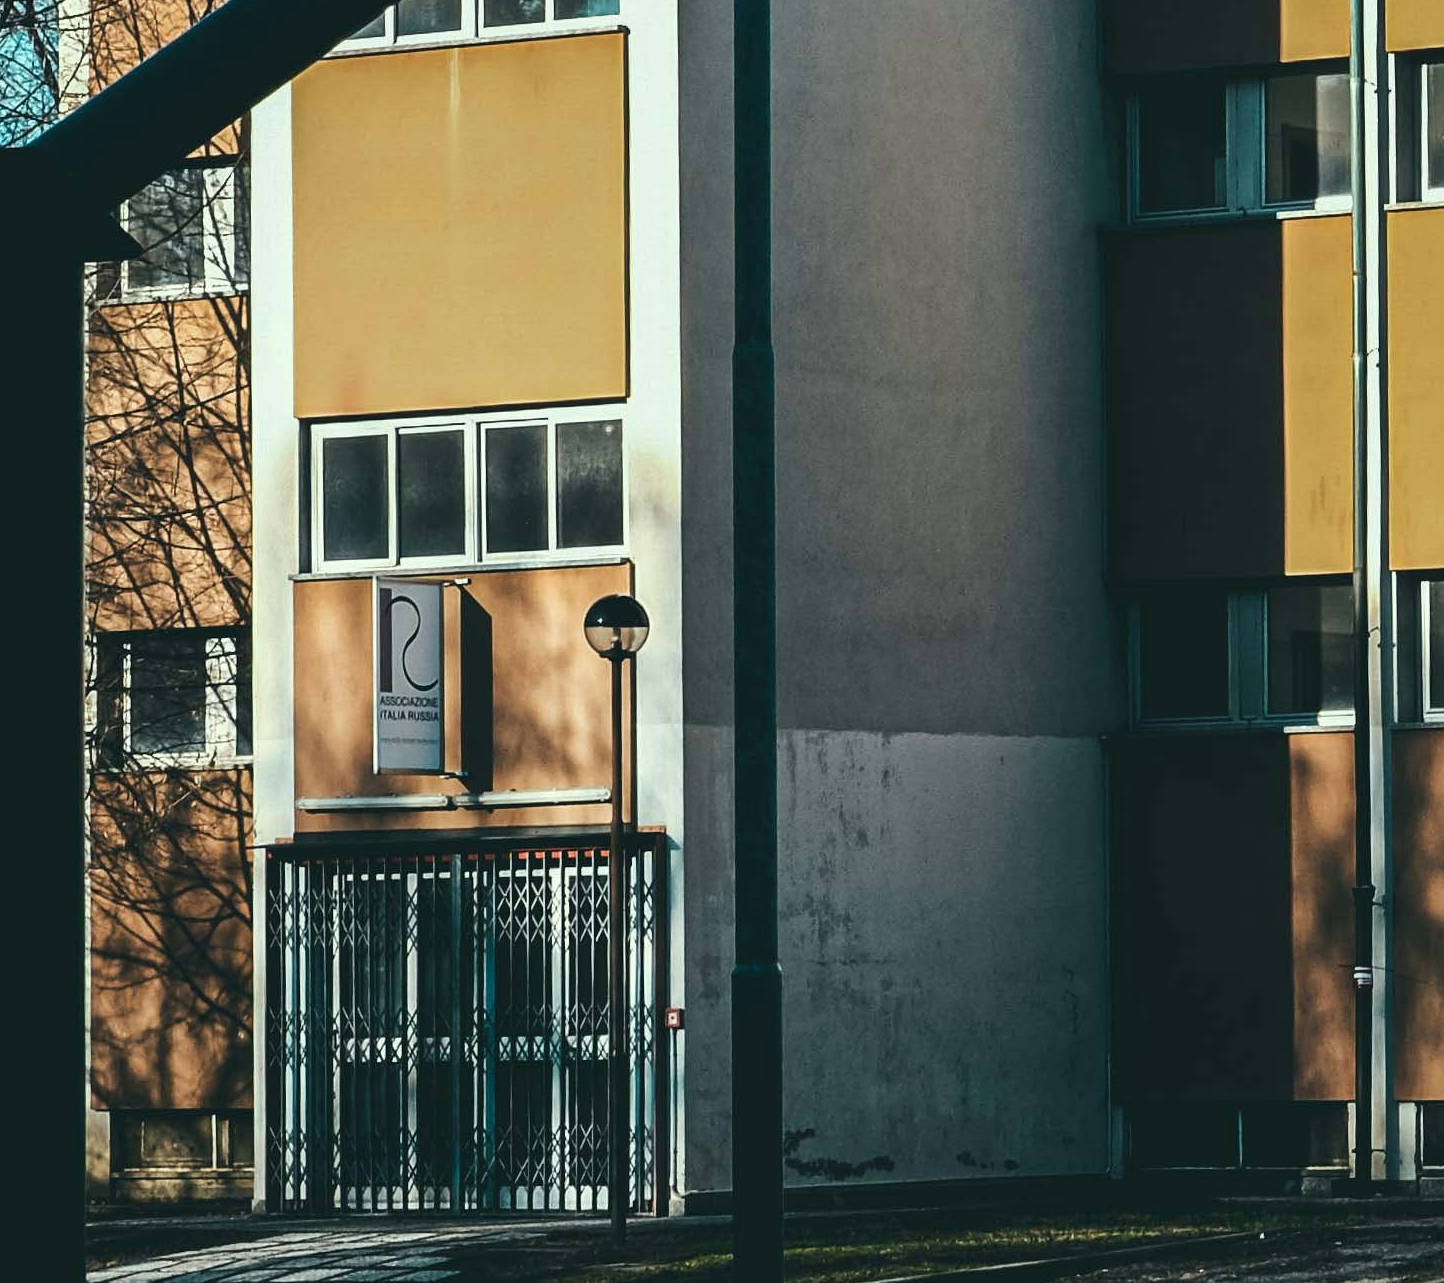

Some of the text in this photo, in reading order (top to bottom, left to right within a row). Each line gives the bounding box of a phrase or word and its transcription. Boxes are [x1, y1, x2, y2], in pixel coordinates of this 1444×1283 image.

[380, 696, 438, 708] ASSOCIAZIONE
[380, 710, 439, 721] ITALIA RUSSIA
